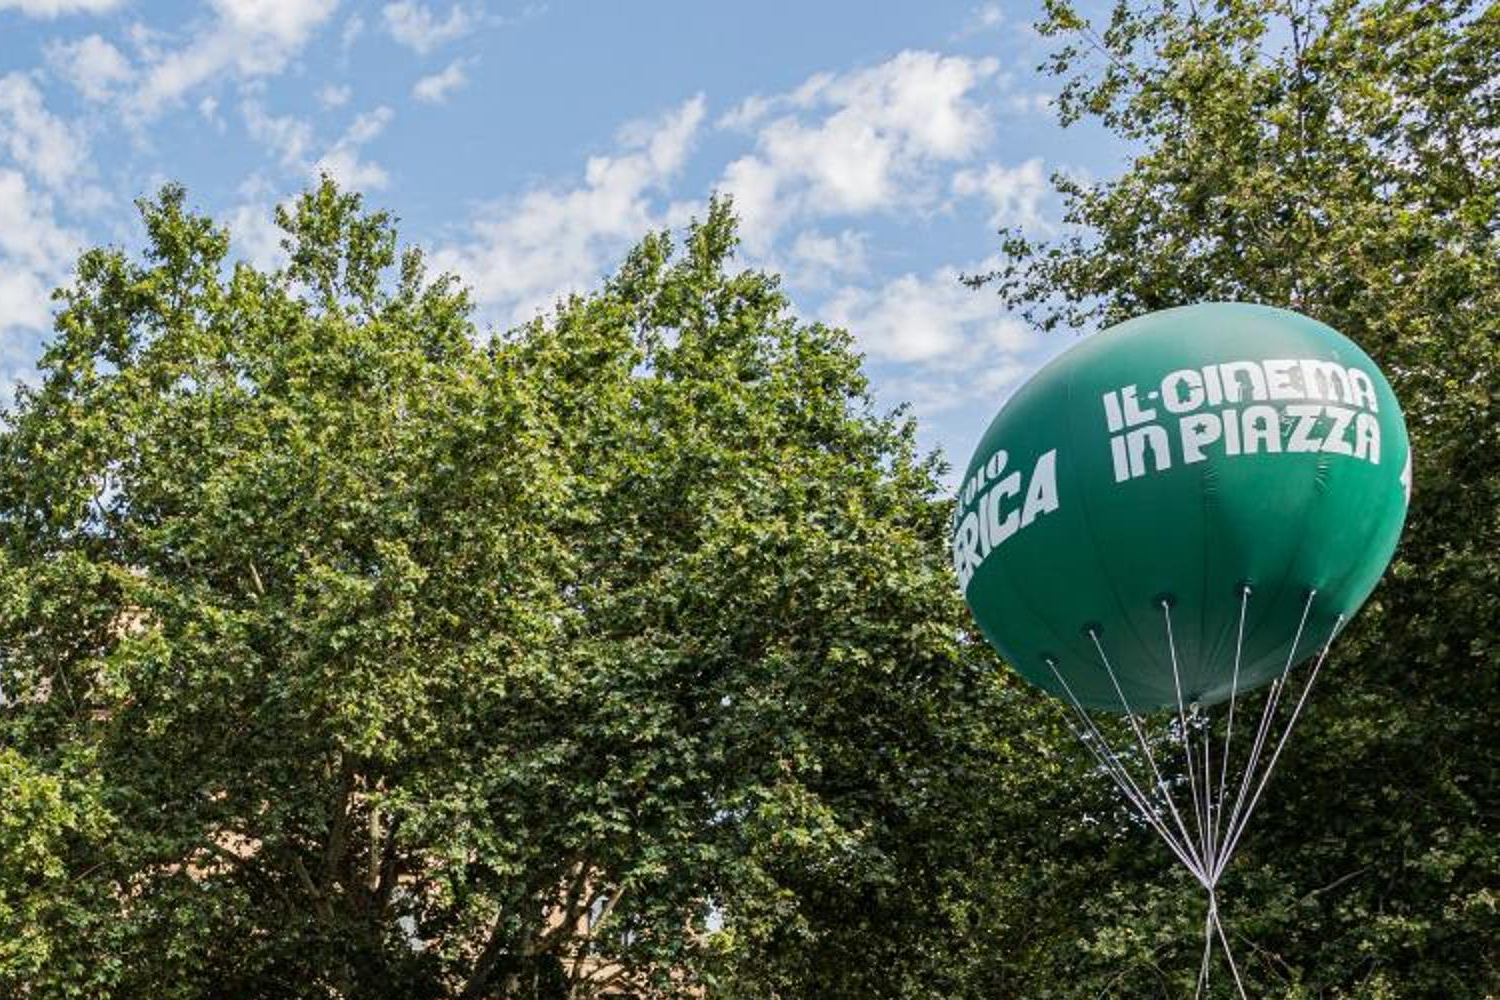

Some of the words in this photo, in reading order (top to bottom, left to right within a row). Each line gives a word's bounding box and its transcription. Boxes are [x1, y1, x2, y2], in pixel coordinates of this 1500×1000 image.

[1161, 359, 1378, 413] CINEMA
[1110, 424, 1172, 483] IN
[1179, 404, 1380, 465] PIAZZA
